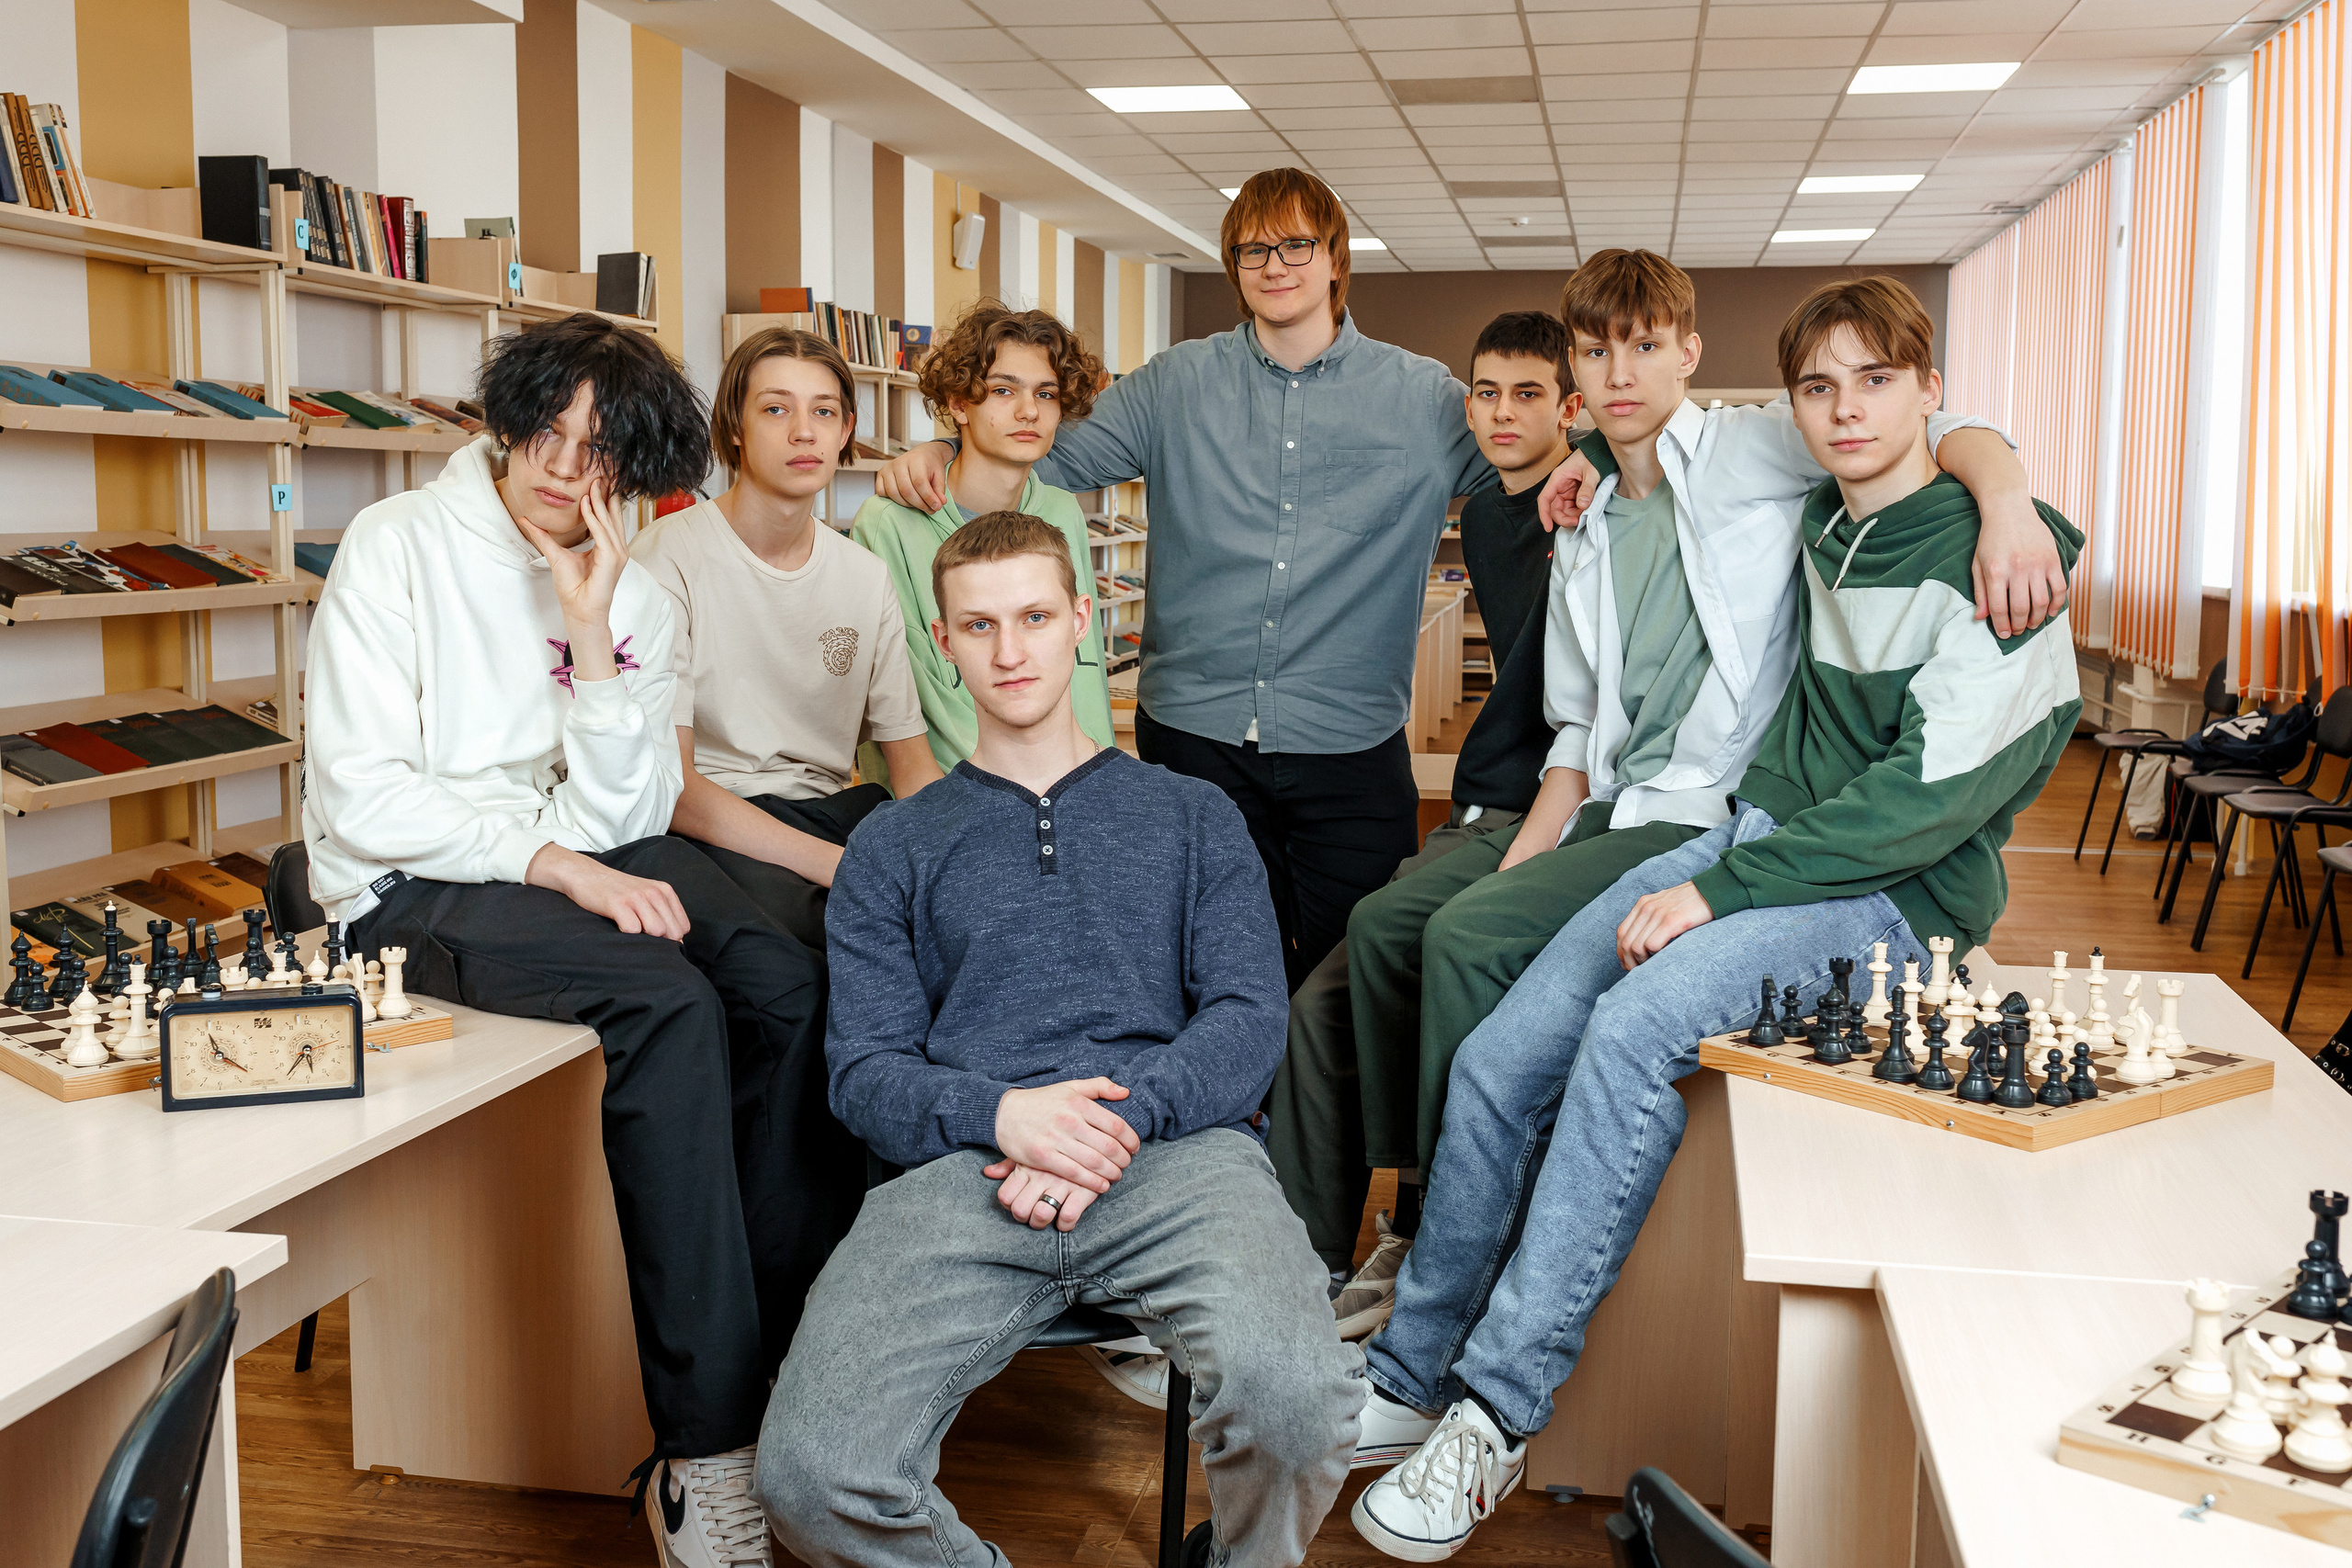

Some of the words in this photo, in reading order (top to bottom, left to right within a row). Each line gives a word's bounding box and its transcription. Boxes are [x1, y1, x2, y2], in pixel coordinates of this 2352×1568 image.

[2154, 1364, 2172, 1373] 6
[2098, 1404, 2116, 1414] 8
[2126, 1432, 2150, 1443] H
[2205, 1453, 2227, 1466] G
[2287, 1476, 2309, 1486] F
